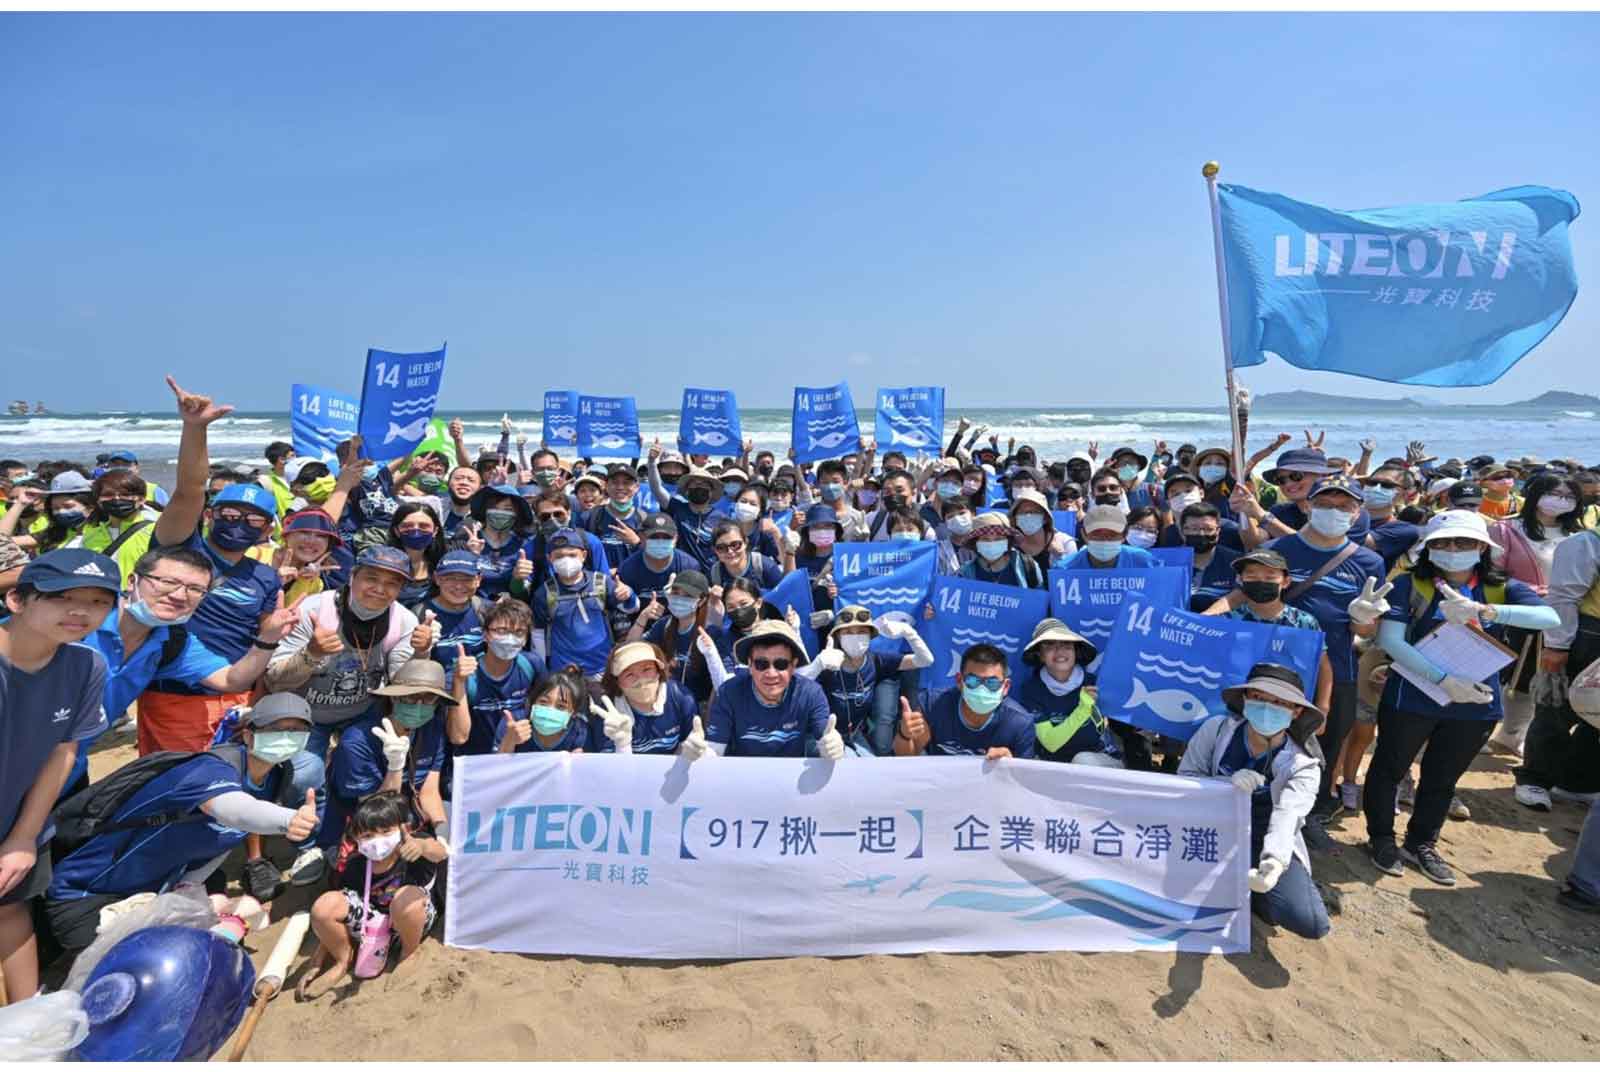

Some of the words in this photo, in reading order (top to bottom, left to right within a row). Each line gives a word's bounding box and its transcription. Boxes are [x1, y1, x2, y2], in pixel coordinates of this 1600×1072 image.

[1274, 231, 1517, 280] LITEON
[375, 361, 400, 388] 14
[408, 363, 423, 375] LIFE
[406, 375, 430, 388] WATER
[299, 393, 321, 416] 14
[581, 400, 592, 416] 14
[687, 393, 698, 409] 14
[798, 393, 810, 412] 14
[881, 394, 896, 410] 14
[327, 409, 355, 423] WATER
[840, 553, 862, 577] 14
[868, 551, 883, 564] LIFE
[883, 550, 913, 563] BELOW
[868, 565, 895, 577] WATER
[1056, 578, 1083, 605] 14
[1089, 577, 1109, 590] LIFE
[1110, 577, 1145, 592] BELOW
[939, 587, 962, 614] 14
[969, 591, 988, 605] LIFE
[989, 593, 1021, 609] BELOW
[967, 604, 999, 620] WATER
[1126, 602, 1155, 636] 14
[1162, 612, 1185, 629] LIFE
[1184, 621, 1227, 638] BELOW
[1160, 626, 1194, 647] WATER
[463, 803, 652, 857] LITEON
[953, 814, 1220, 864] 企業聯合淨灘
